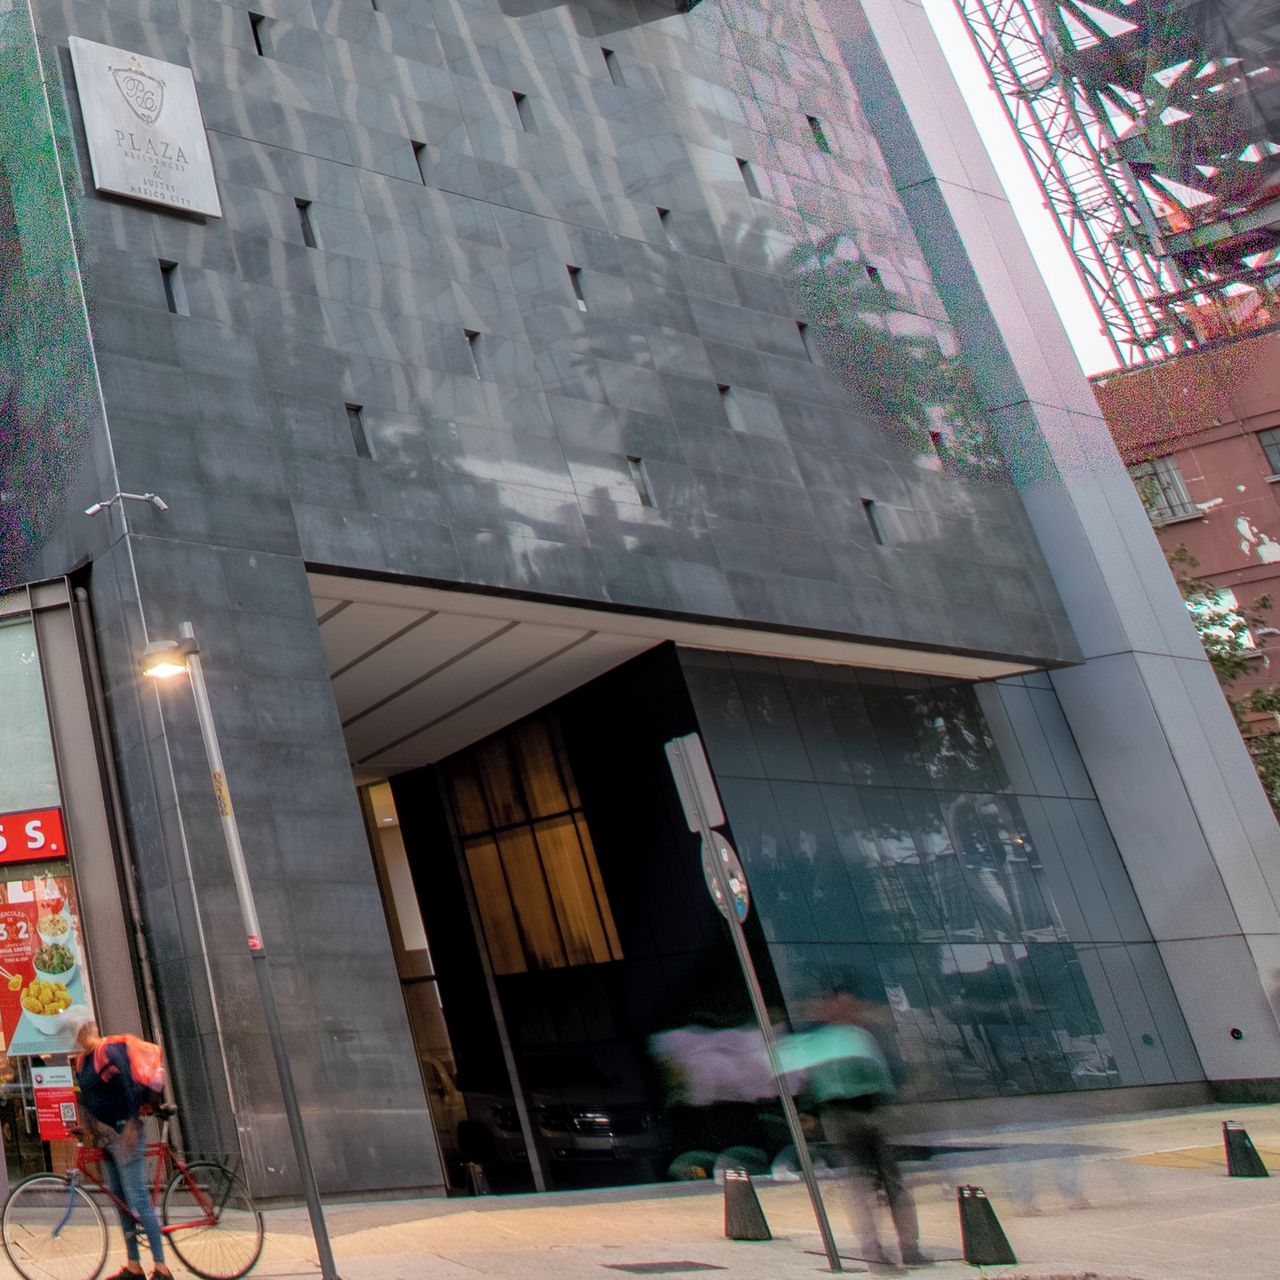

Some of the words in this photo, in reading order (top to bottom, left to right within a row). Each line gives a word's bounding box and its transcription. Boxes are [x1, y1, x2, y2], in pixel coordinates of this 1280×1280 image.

[113, 129, 189, 165] PLAZA
[152, 165, 162, 179] &
[142, 178, 175, 193] SUITES
[130, 185, 166, 200] MEXICO
[170, 194, 190, 206] CITY
